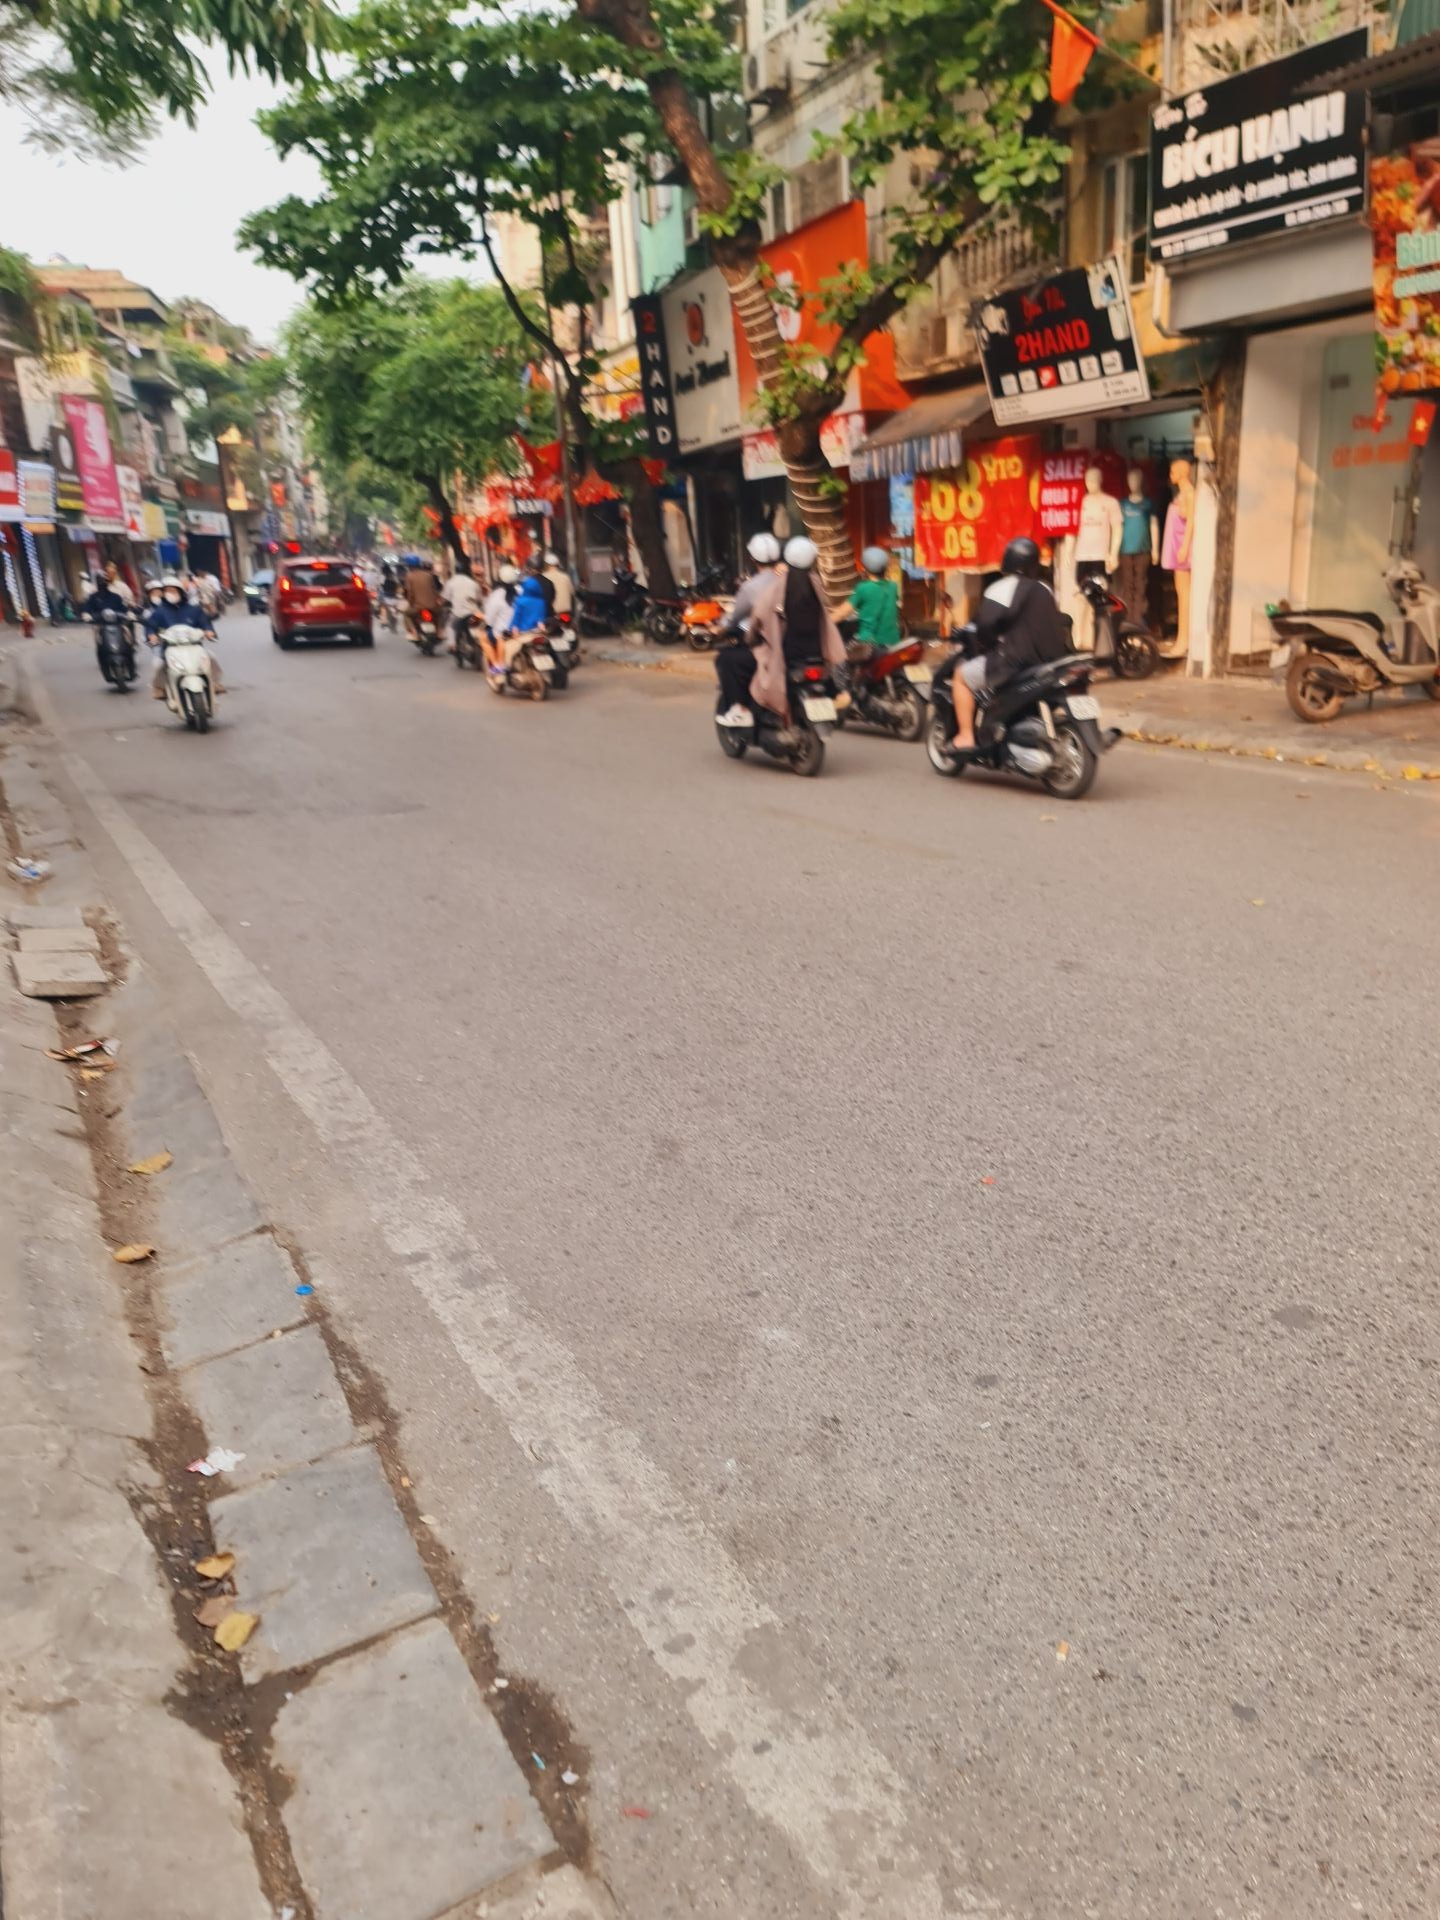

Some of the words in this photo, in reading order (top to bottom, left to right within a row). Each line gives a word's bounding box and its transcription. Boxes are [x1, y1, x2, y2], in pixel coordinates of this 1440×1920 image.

[1241, 90, 1346, 164] HẠNH
[1014, 318, 1091, 364] 2HAND
[1043, 456, 1084, 482] SALE
